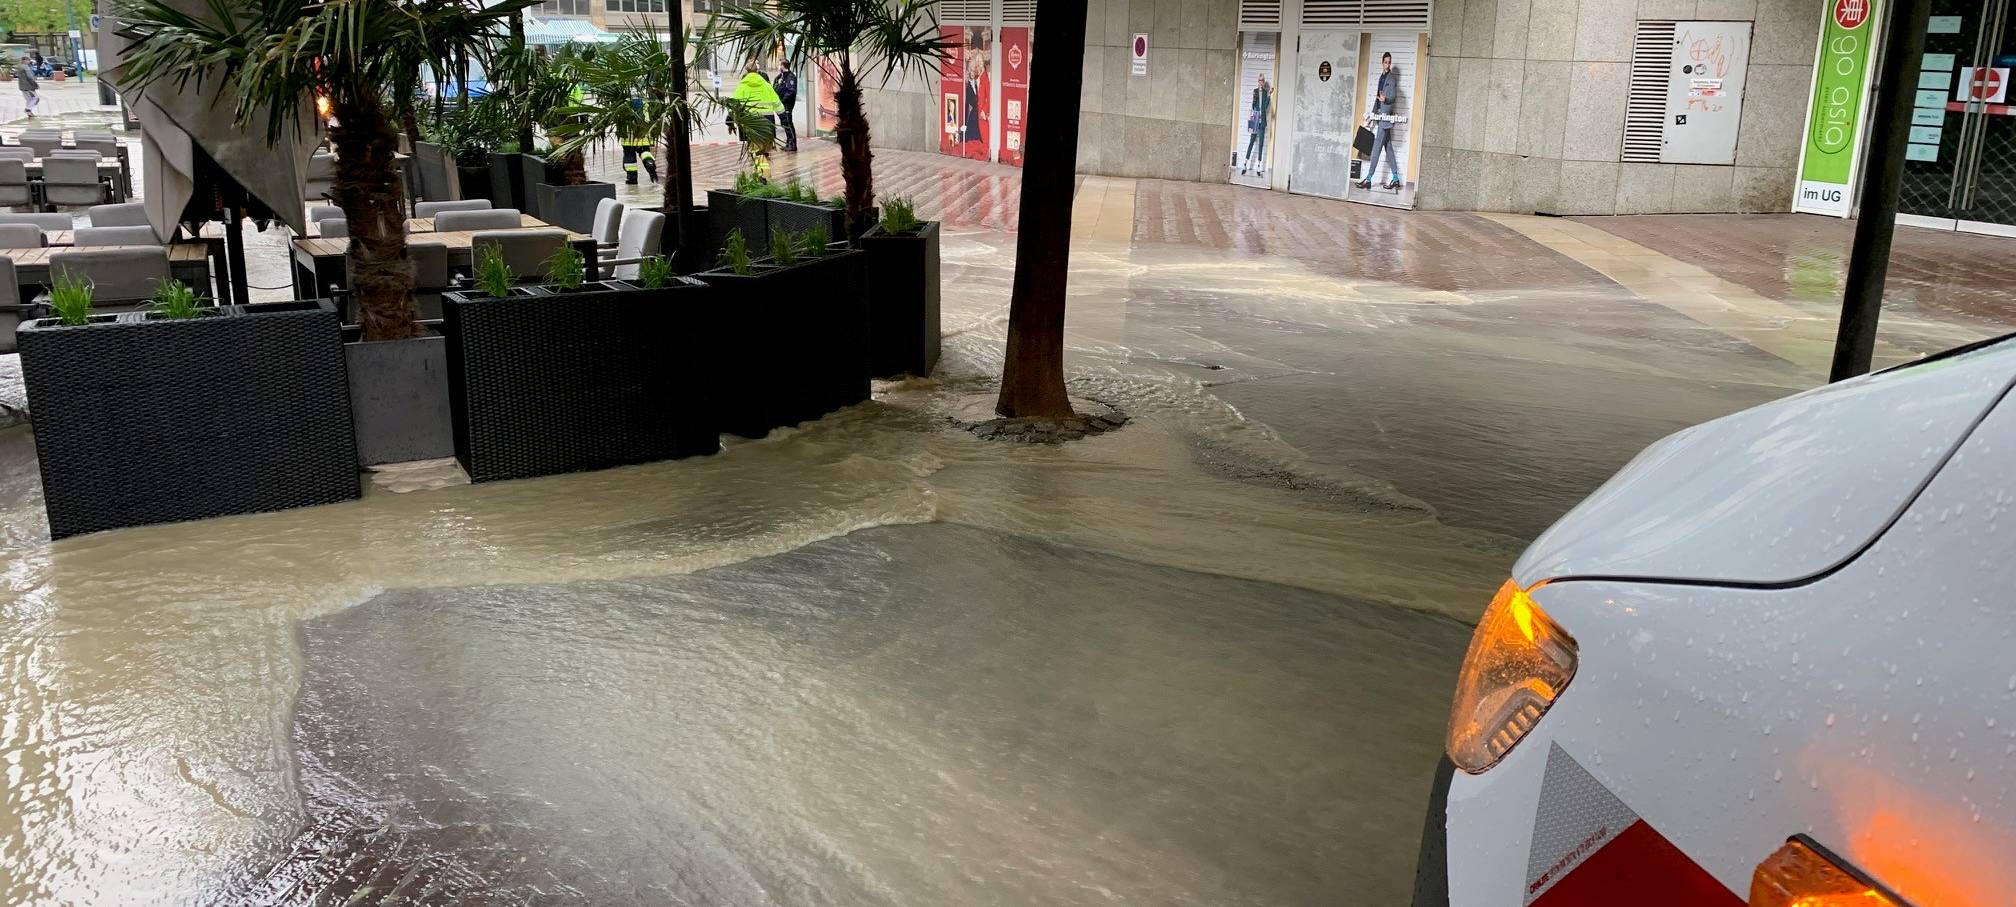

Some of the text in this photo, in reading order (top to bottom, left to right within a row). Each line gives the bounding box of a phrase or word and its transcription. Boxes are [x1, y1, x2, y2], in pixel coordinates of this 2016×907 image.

[1831, 35, 1858, 76] go
[1369, 112, 1407, 124] Burlington
[1824, 86, 1851, 146] asia
[1803, 187, 1842, 202] im UG
